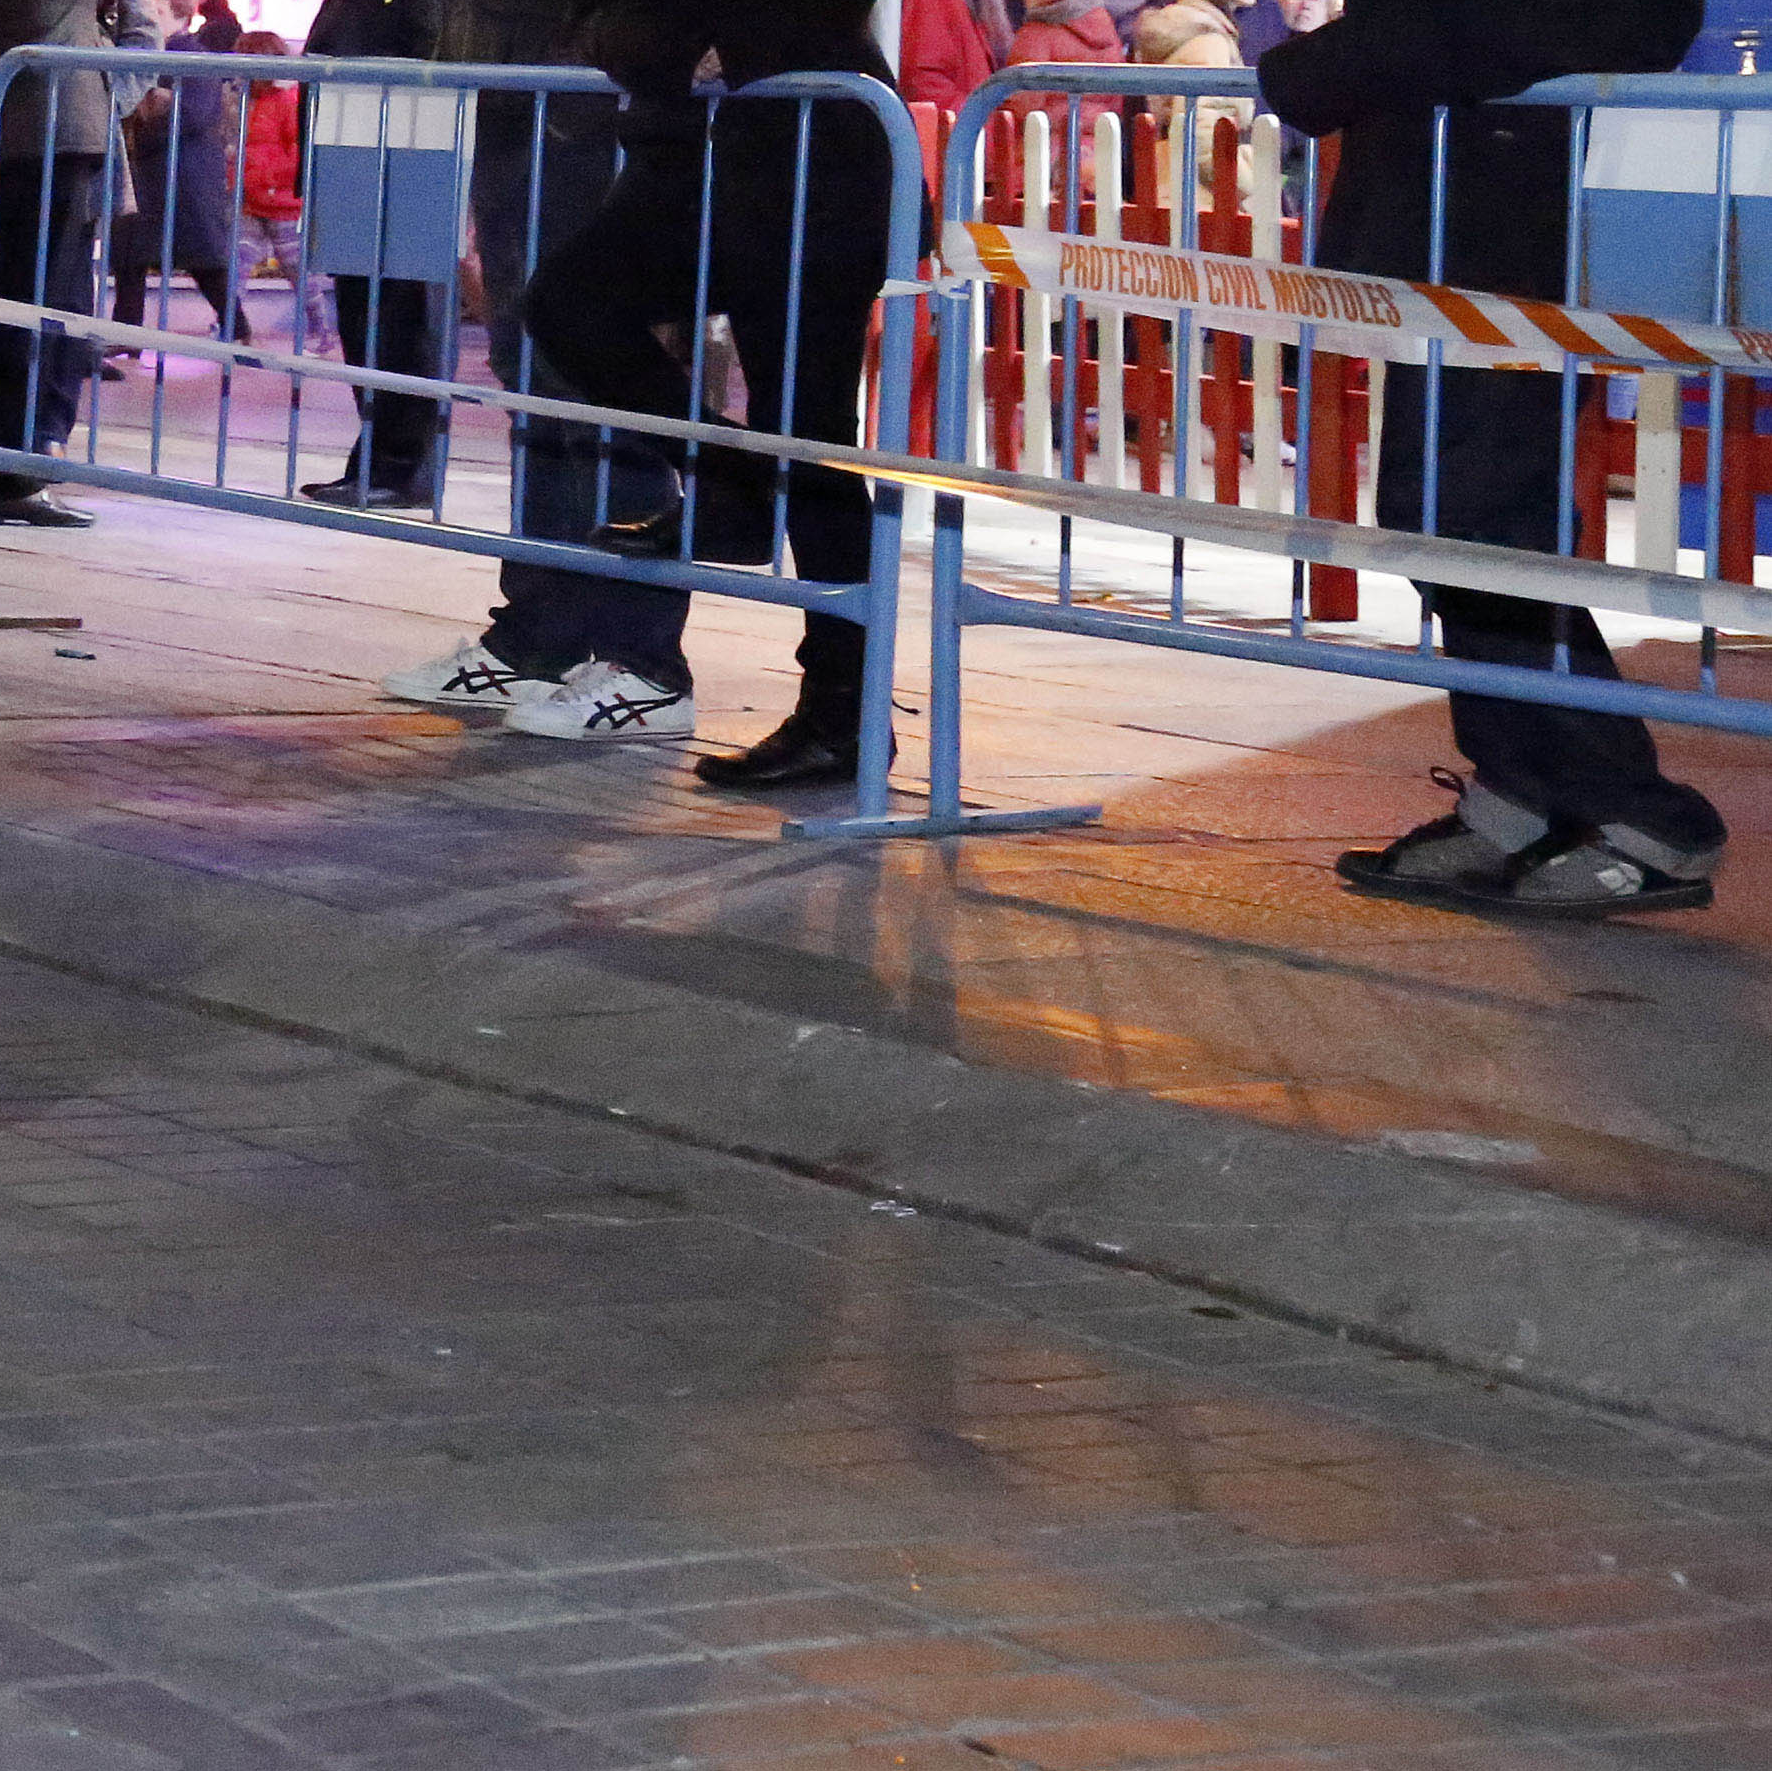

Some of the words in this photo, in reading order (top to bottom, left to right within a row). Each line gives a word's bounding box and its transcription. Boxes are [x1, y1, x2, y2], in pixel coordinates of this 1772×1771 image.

[1059, 241, 1200, 304] PROTECCION
[1203, 259, 1267, 312] CIVIL
[1266, 268, 1402, 329] MOSTOLES
